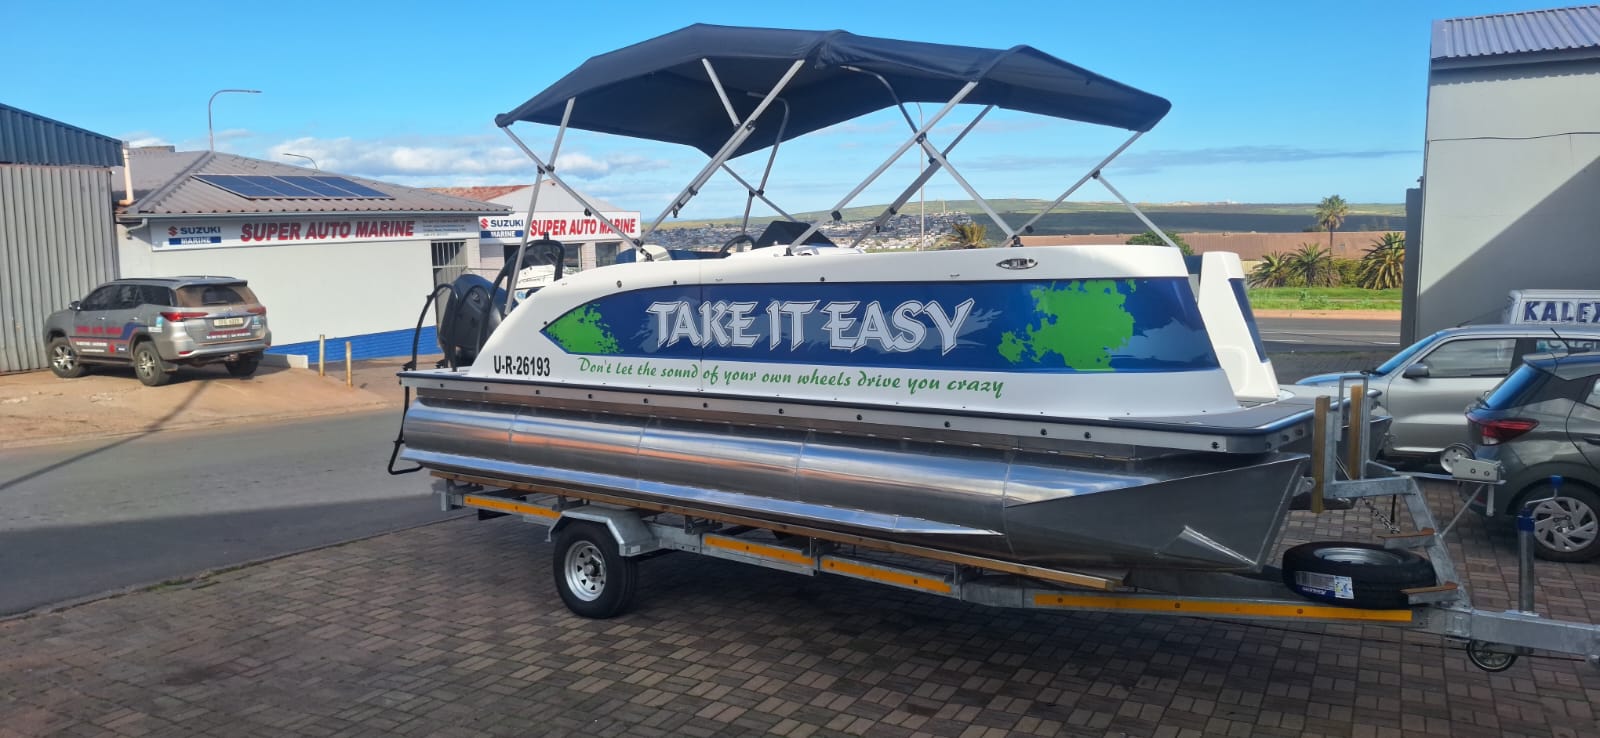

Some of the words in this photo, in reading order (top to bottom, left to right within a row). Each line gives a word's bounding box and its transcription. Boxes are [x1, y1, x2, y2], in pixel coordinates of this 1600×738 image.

[180, 226, 221, 235] SUZUKI
[240, 223, 302, 242] SUPER
[305, 221, 351, 240] AUTO
[355, 220, 416, 238] MARINE
[498, 218, 524, 228] SUZUKI
[530, 219, 567, 236] SUPER
[568, 219, 597, 234] AUTO
[180, 236, 211, 245] MARINE
[490, 230, 516, 238] MARINE
[645, 300, 759, 349] TAKE
[765, 298, 821, 352] IT
[819, 297, 976, 357] EASY
[493, 355, 551, 377] U-R-26193
[577, 357, 612, 373] Don't
[637, 361, 657, 376] the
[660, 364, 698, 378] sound
[702, 365, 719, 384] of
[724, 370, 757, 385] your
[761, 372, 792, 384] own
[797, 368, 851, 386] wheels
[857, 371, 901, 388] drive
[908, 378, 940, 395] you
[947, 380, 1004, 399] crazy
